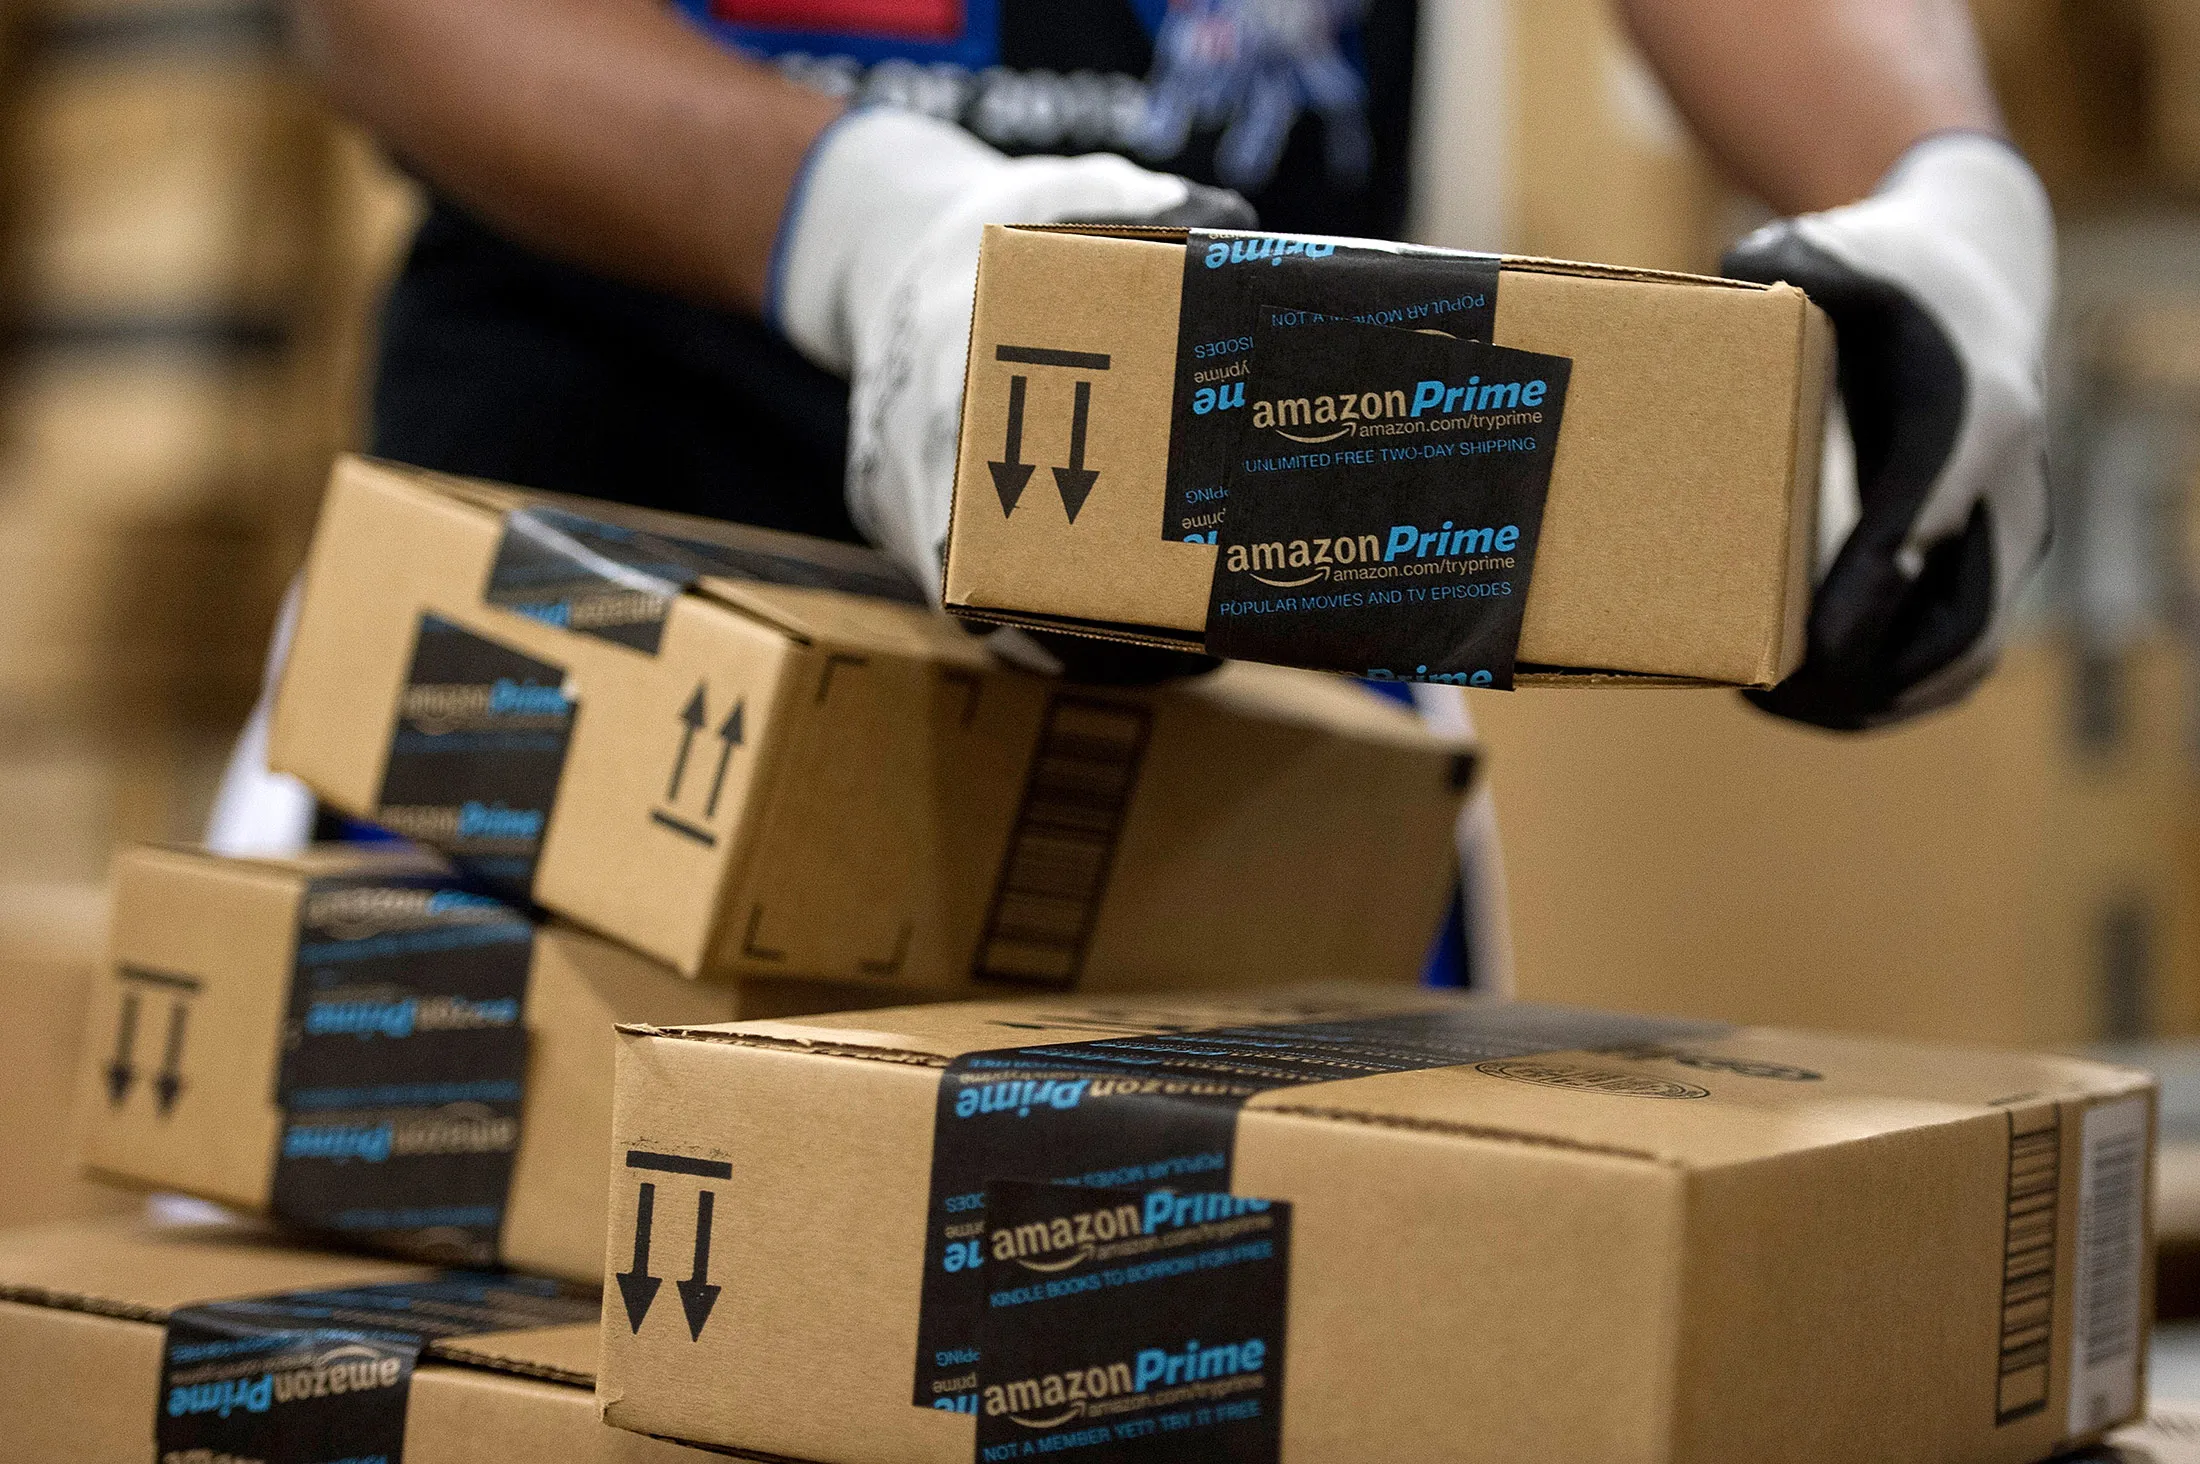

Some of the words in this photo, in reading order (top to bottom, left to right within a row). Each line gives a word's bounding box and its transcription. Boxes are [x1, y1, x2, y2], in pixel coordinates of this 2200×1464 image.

[1406, 294, 1485, 320] POPULAR
[1194, 336, 1254, 359] ISODES
[1253, 390, 1405, 429] amazon
[1410, 376, 1548, 418] Prime
[1359, 411, 1544, 438] amazon.com/tryprime
[1245, 453, 1331, 473] UNLIMITED
[1335, 449, 1375, 465] FREE
[1380, 443, 1455, 462] TWO-DAY
[1459, 436, 1537, 456] SHIPPING
[1227, 534, 1381, 573] amazon
[1384, 521, 1520, 563] Prime
[1333, 556, 1516, 582] amazon.com/tryprime
[1220, 598, 1298, 616] POPULAR
[1302, 592, 1364, 610] MOVIES
[1368, 589, 1402, 605] AND
[1407, 587, 1427, 602] TV
[1431, 581, 1512, 600] EPISODES
[956, 1079, 1090, 1119] Prime
[283, 1123, 393, 1163] Prime
[991, 1205, 1141, 1261] amazon
[1046, 1273, 1100, 1297] BOOKS
[1103, 1267, 1126, 1286] TO
[167, 1373, 274, 1418] Prime
[274, 1356, 401, 1403] amazon
[984, 1362, 1133, 1416] amazon
[1134, 1338, 1265, 1392] Prime
[983, 1444, 1017, 1463] NOT
[1022, 1441, 1035, 1456] A
[1038, 1426, 1111, 1452] MEMBER
[1114, 1418, 1154, 1439] YET?
[1159, 1410, 1192, 1431] TRY
[1196, 1406, 1212, 1425] IT
[1215, 1399, 1260, 1420] FREE
